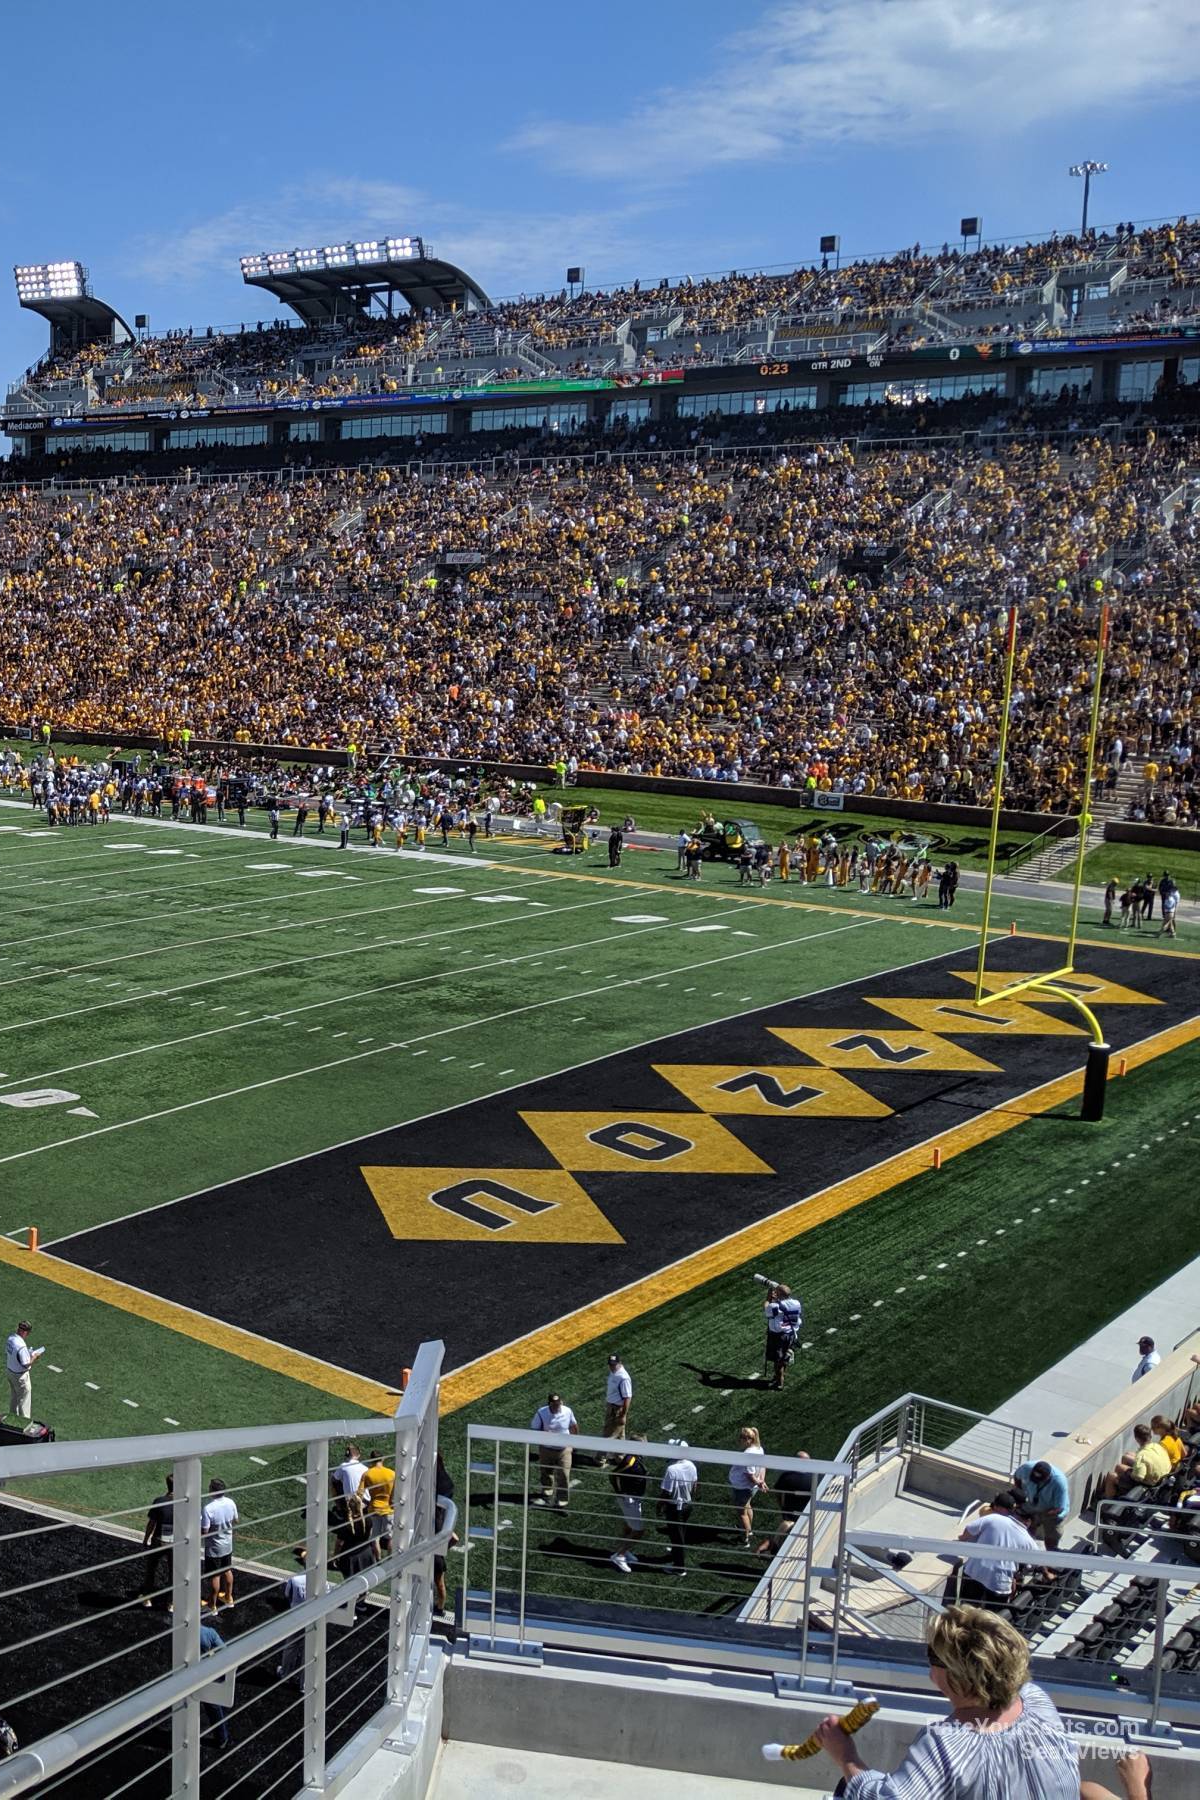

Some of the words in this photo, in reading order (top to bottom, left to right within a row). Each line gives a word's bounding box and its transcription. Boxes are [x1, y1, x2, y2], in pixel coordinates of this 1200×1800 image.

[811, 361, 827, 370] QTR
[831, 358, 851, 369] 2ND
[760, 364, 789, 376] 0:23
[647, 373, 663, 384] 31
[7, 420, 44, 431] Mediacom
